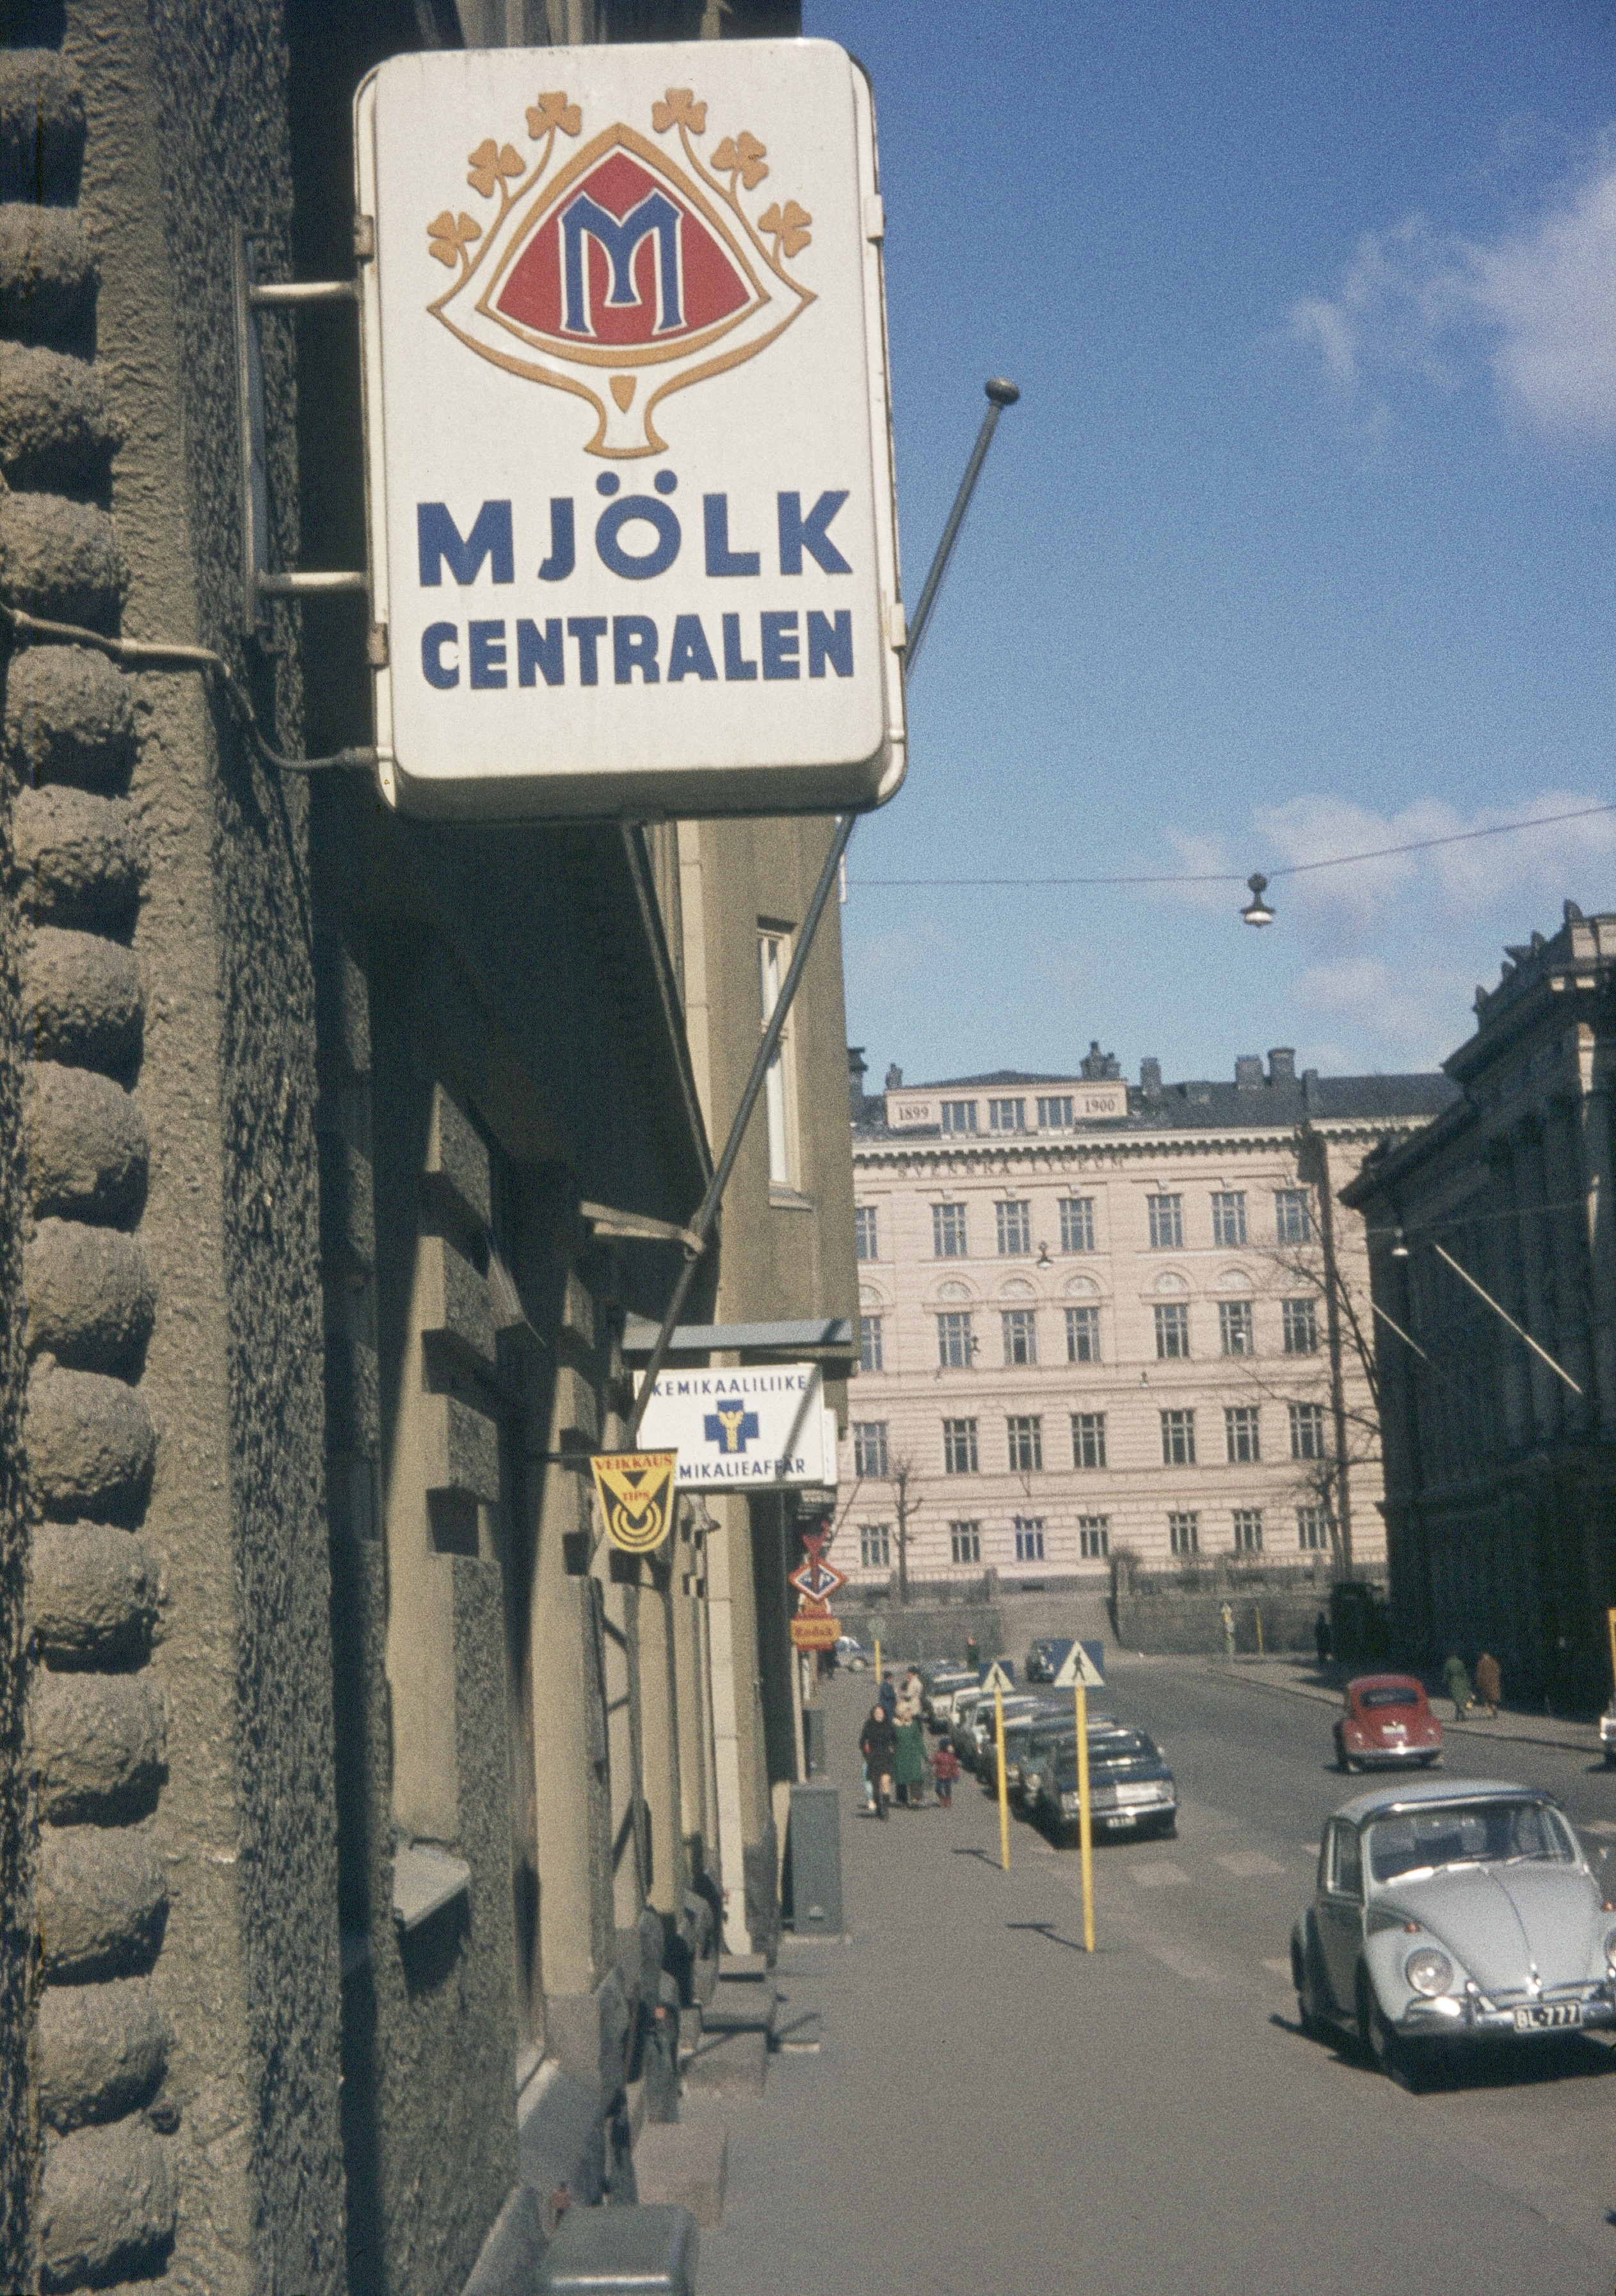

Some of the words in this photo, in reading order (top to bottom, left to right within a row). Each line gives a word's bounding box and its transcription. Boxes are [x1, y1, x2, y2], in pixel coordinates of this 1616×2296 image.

[559, 190, 686, 335] M
[417, 469, 853, 587] MJÖLK
[420, 610, 854, 690] CENTRALEN
[898, 1106, 929, 1120] 1899
[1085, 1098, 1116, 1113] 1900
[652, 1375, 806, 1396] KEMIKAALILIIKE
[594, 1452, 673, 1471] VEIKKAUS
[674, 1455, 805, 1479] MIKALIEAFFÄR
[621, 1490, 650, 1501] TIPS
